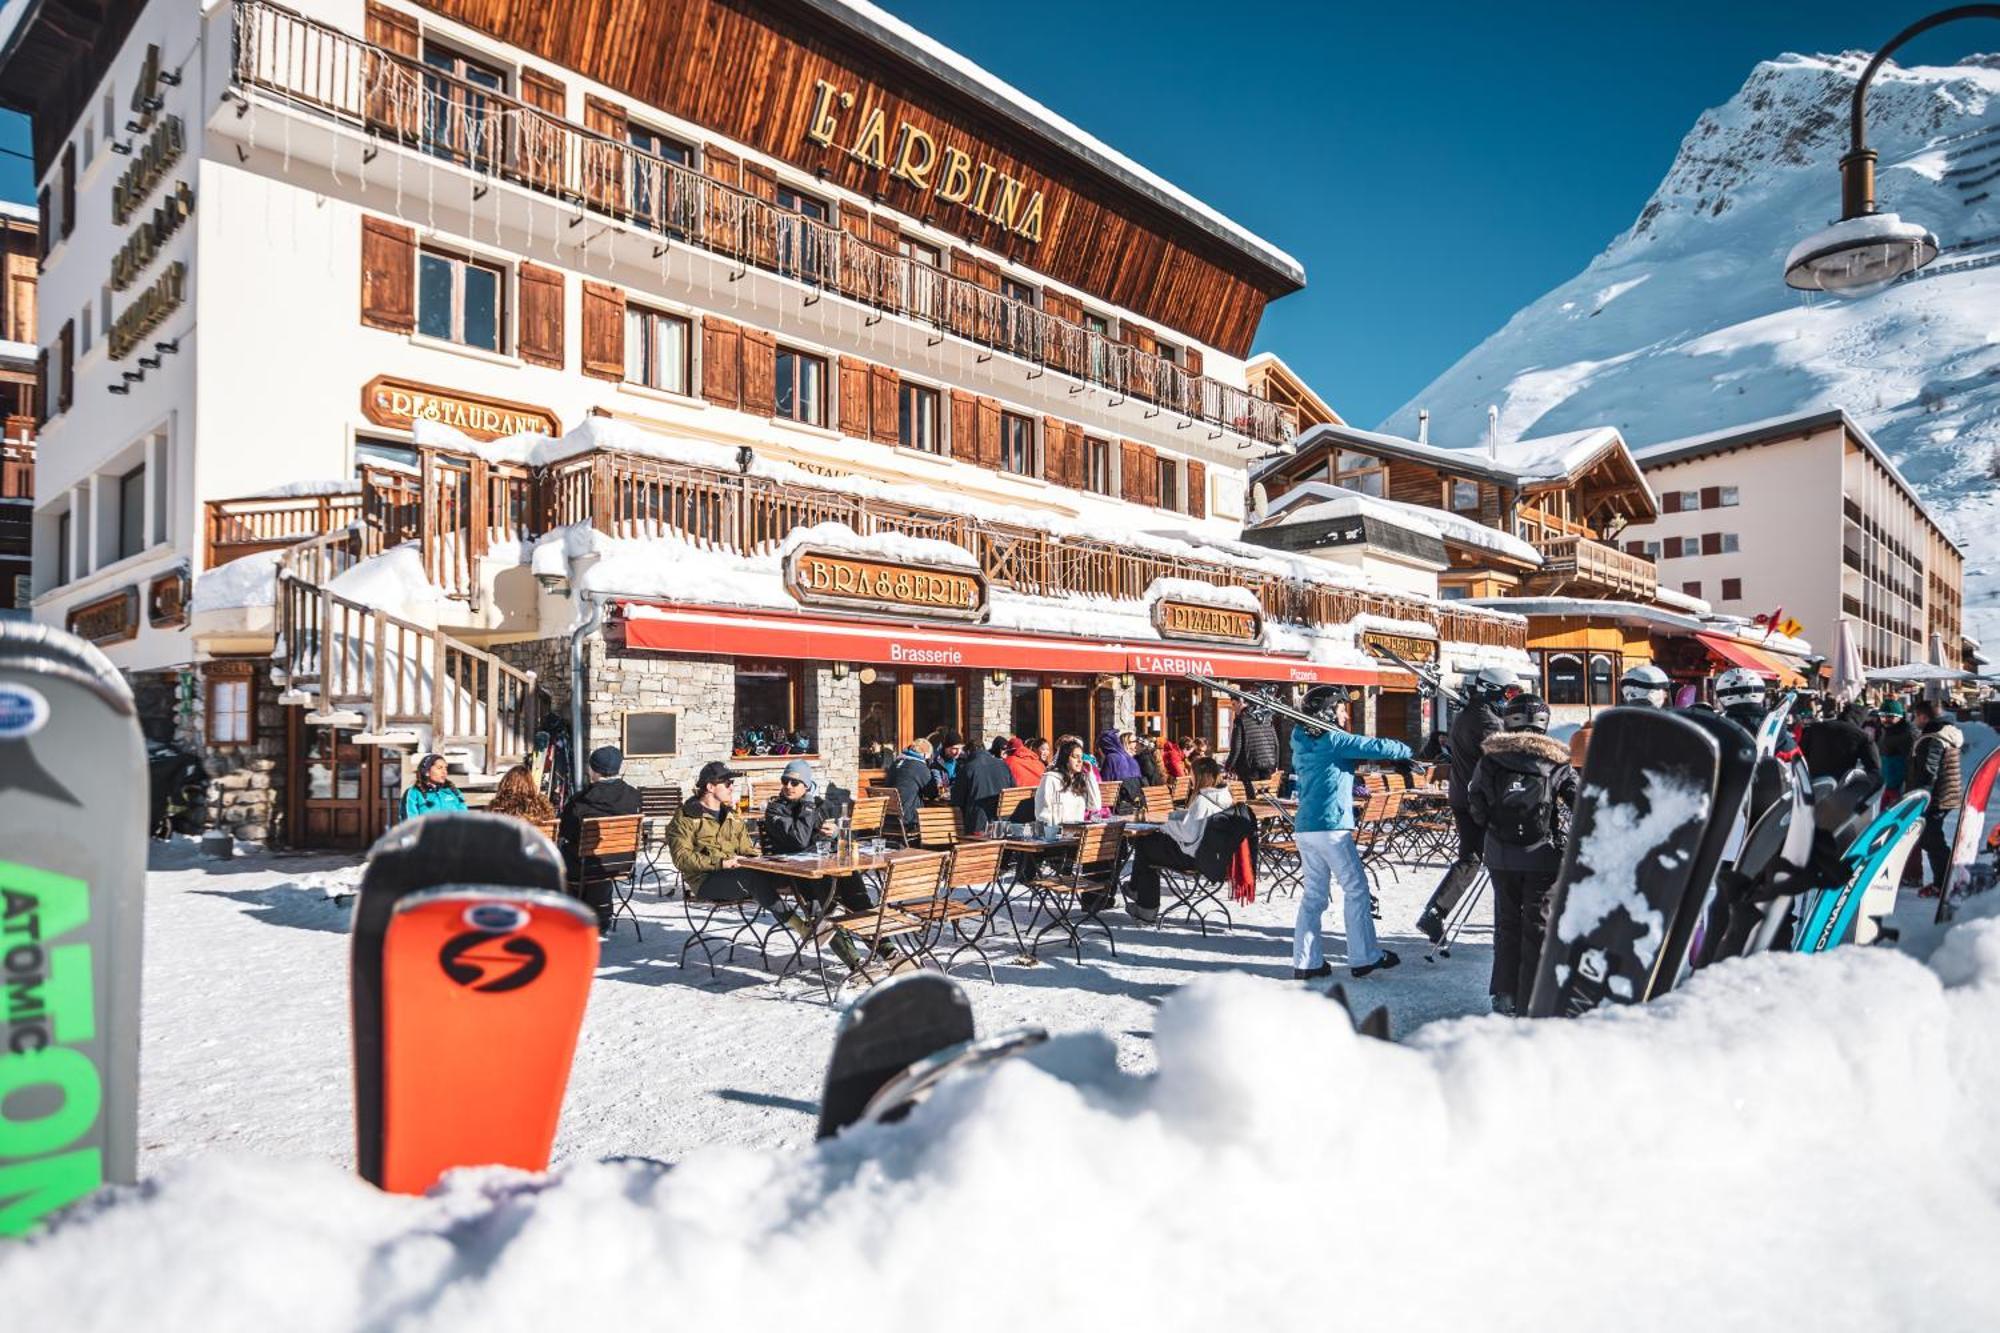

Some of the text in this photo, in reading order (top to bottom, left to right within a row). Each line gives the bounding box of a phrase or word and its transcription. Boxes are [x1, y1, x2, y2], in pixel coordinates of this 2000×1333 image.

[808, 78, 1045, 243] L'ARBINA
[391, 391, 540, 435] RESTAURANT
[811, 561, 969, 607] BRASSERIE
[1173, 607, 1244, 635] PIZZERIA
[891, 643, 962, 664] Brasserie
[1135, 655, 1214, 676] L'ARBINA
[1290, 667, 1317, 681] Pizzeria
[1816, 864, 1866, 951] DYNASTAR
[1, 886, 49, 1057] ATOMIC
